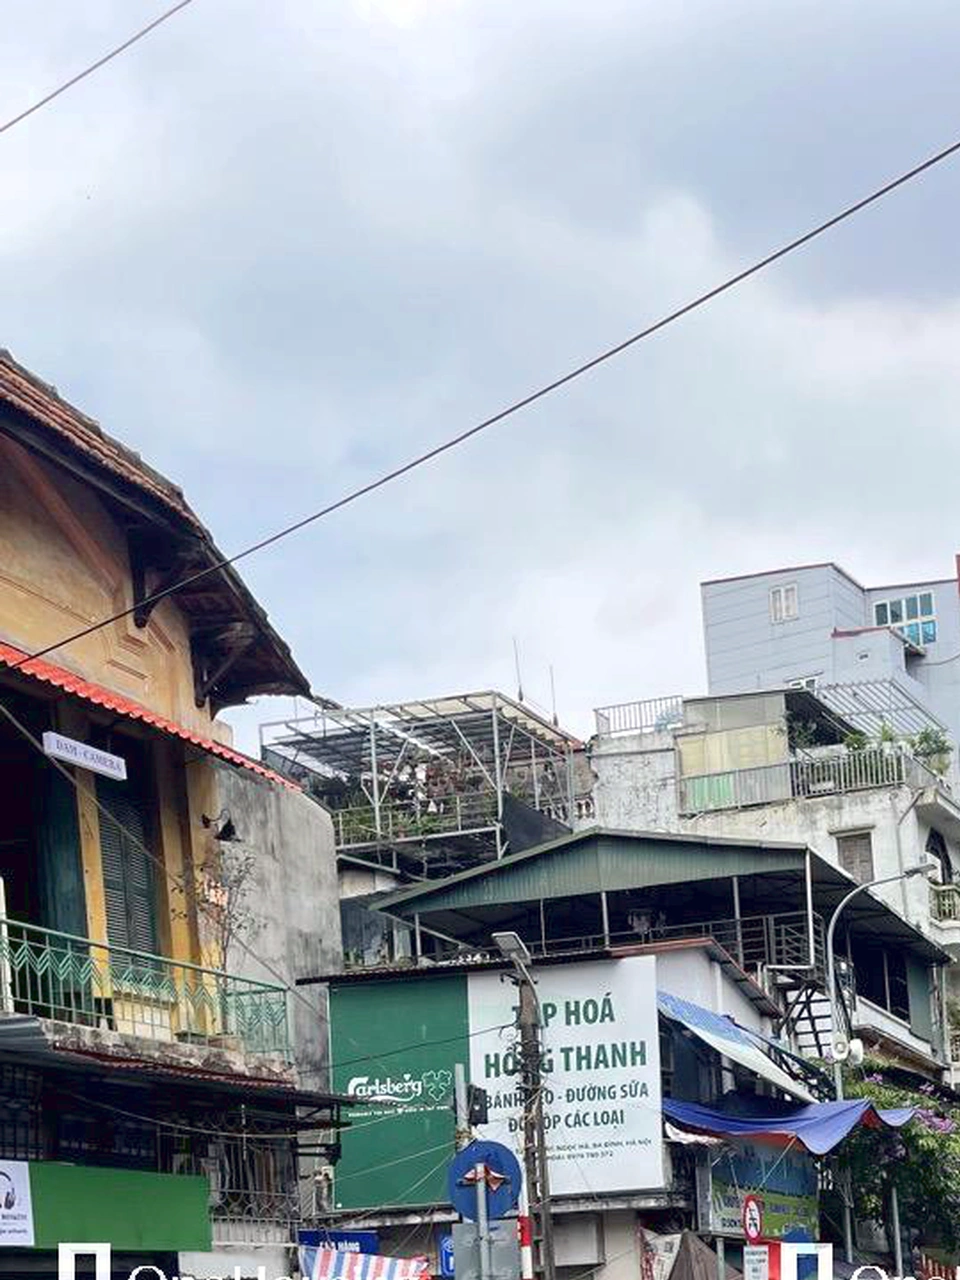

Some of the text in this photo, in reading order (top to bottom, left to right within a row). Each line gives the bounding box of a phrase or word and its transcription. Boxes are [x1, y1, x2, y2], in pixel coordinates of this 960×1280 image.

[565, 992, 615, 1026] HOÁ
[485, 1041, 647, 1078] HỒG THANH
[348, 1075, 422, 1097] Carlsberg
[566, 1083, 617, 1103] ĐƯỜNG
[620, 1080, 649, 1099] SỮA
[564, 1111, 590, 1129] CÁC
[593, 1109, 625, 1129] LOẠI
